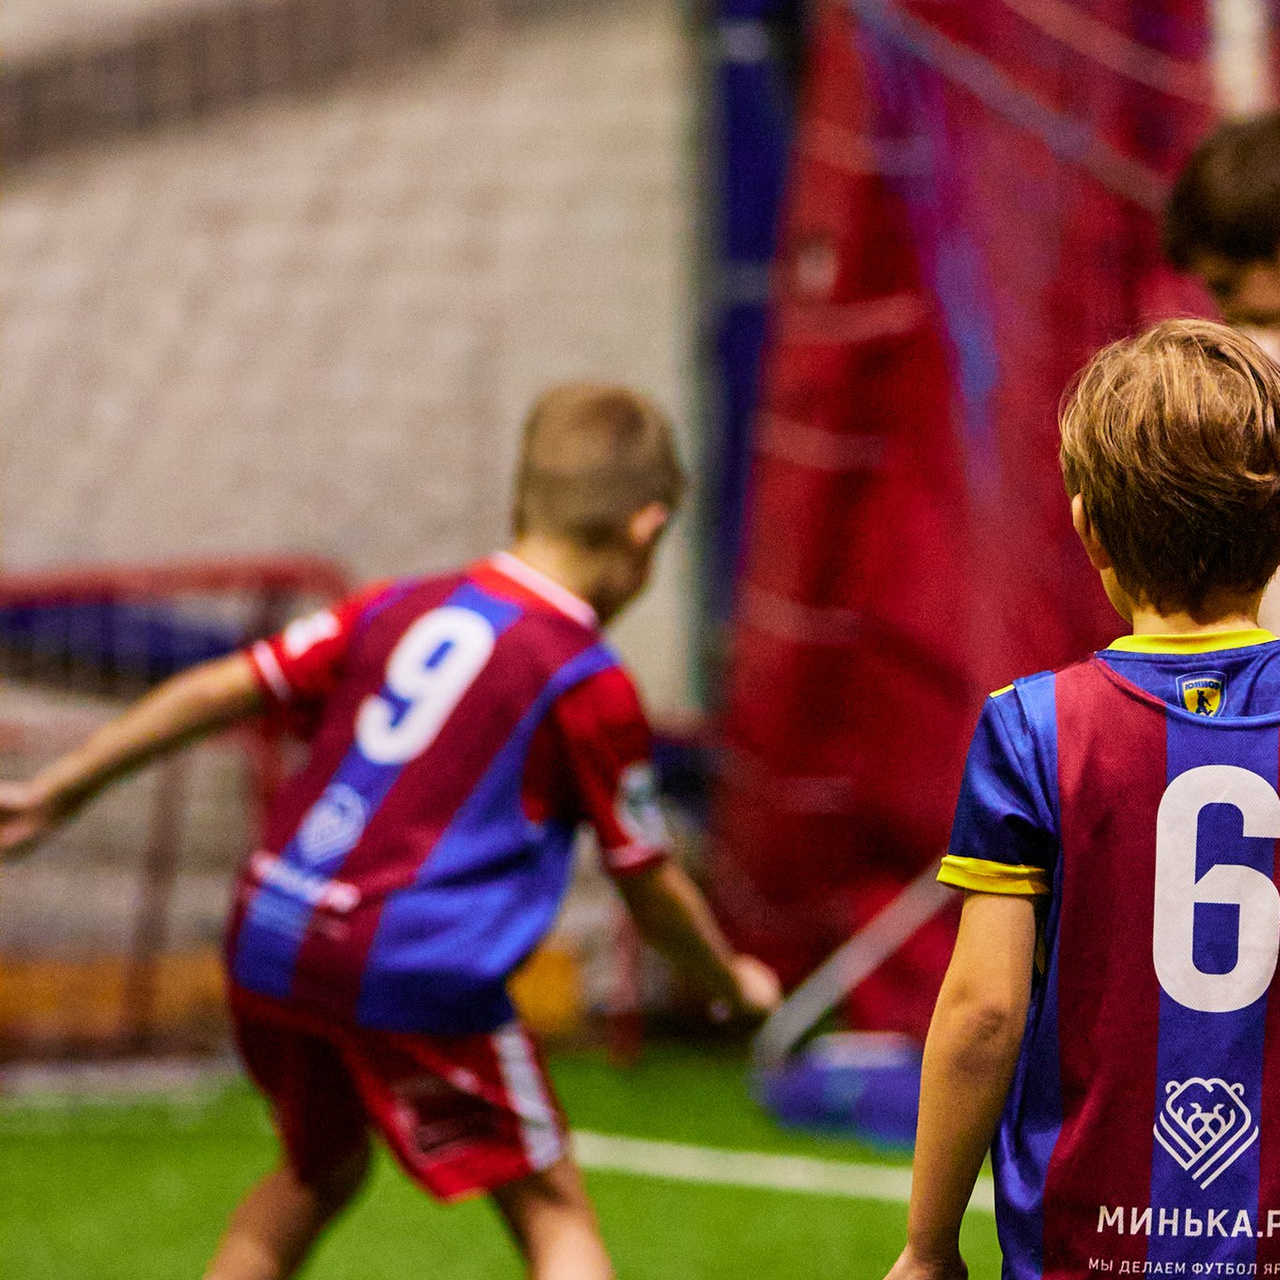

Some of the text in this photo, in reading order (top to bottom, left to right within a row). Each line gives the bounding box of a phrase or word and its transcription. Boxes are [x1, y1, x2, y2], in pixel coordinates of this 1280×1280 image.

[355, 605, 497, 765] 9
[1088, 1257, 1113, 1272] МЫ
[1118, 1259, 1186, 1275] ДЕЛАЕМ
[1191, 1261, 1258, 1275] ФУТБОЛ
